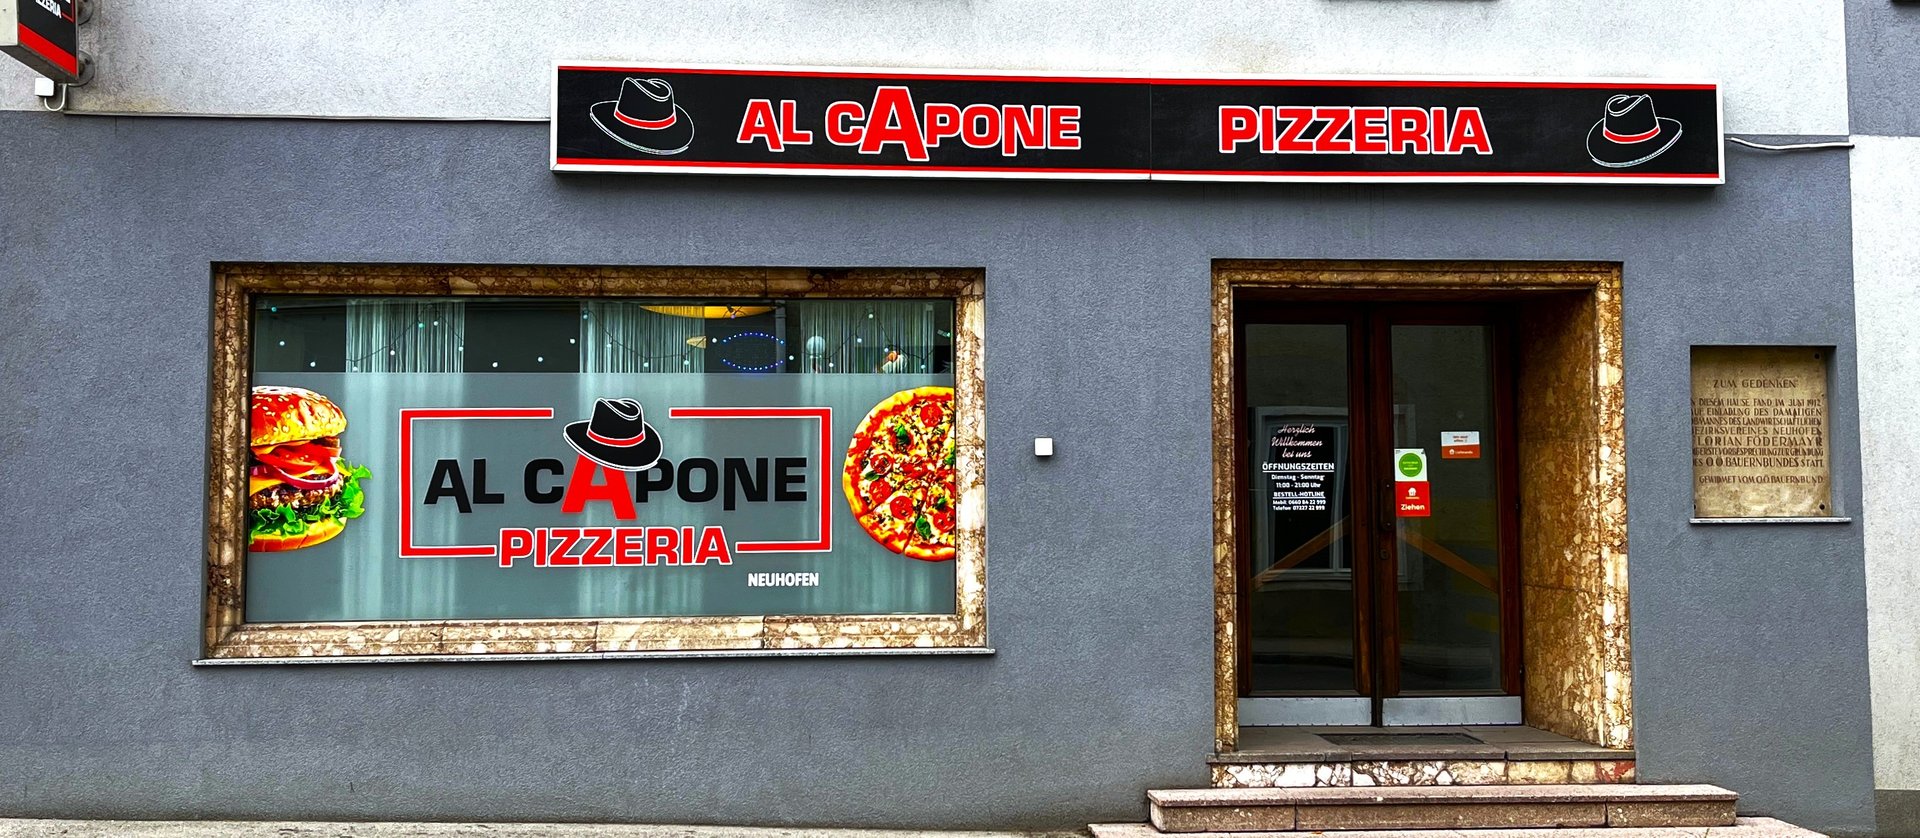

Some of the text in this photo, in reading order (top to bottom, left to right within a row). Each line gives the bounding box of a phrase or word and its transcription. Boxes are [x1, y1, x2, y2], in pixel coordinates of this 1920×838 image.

[737, 86, 1493, 161] AL CAPONE PIZZERIA
[1713, 379, 1796, 388] ZUM GEDENKEN
[1699, 398, 1725, 406] DIESEM
[1726, 398, 1750, 406] HAUSE
[1753, 398, 1772, 407] FAND
[1775, 398, 1785, 407] IM
[1788, 398, 1805, 407] JUNI
[1706, 407, 1750, 416] EINLADUNG
[1753, 407, 1769, 416] DES
[1773, 407, 1822, 417] DAMALIGEN
[1729, 417, 1741, 425] DES
[1277, 423, 1316, 437] Herzlich
[1772, 426, 1823, 436] NEUHOFEN
[1271, 436, 1323, 447] Willkommen
[1282, 448, 1312, 458] bei uns
[1262, 461, 1335, 470] ÖFFNUNGSZEITEN
[1699, 475, 1736, 484] GEWIDMET
[423, 453, 808, 520] AL CAPONE
[1401, 503, 1425, 511] Ziehen
[499, 526, 733, 567] PIZZERIA
[747, 572, 820, 587] NEUHOFEN
